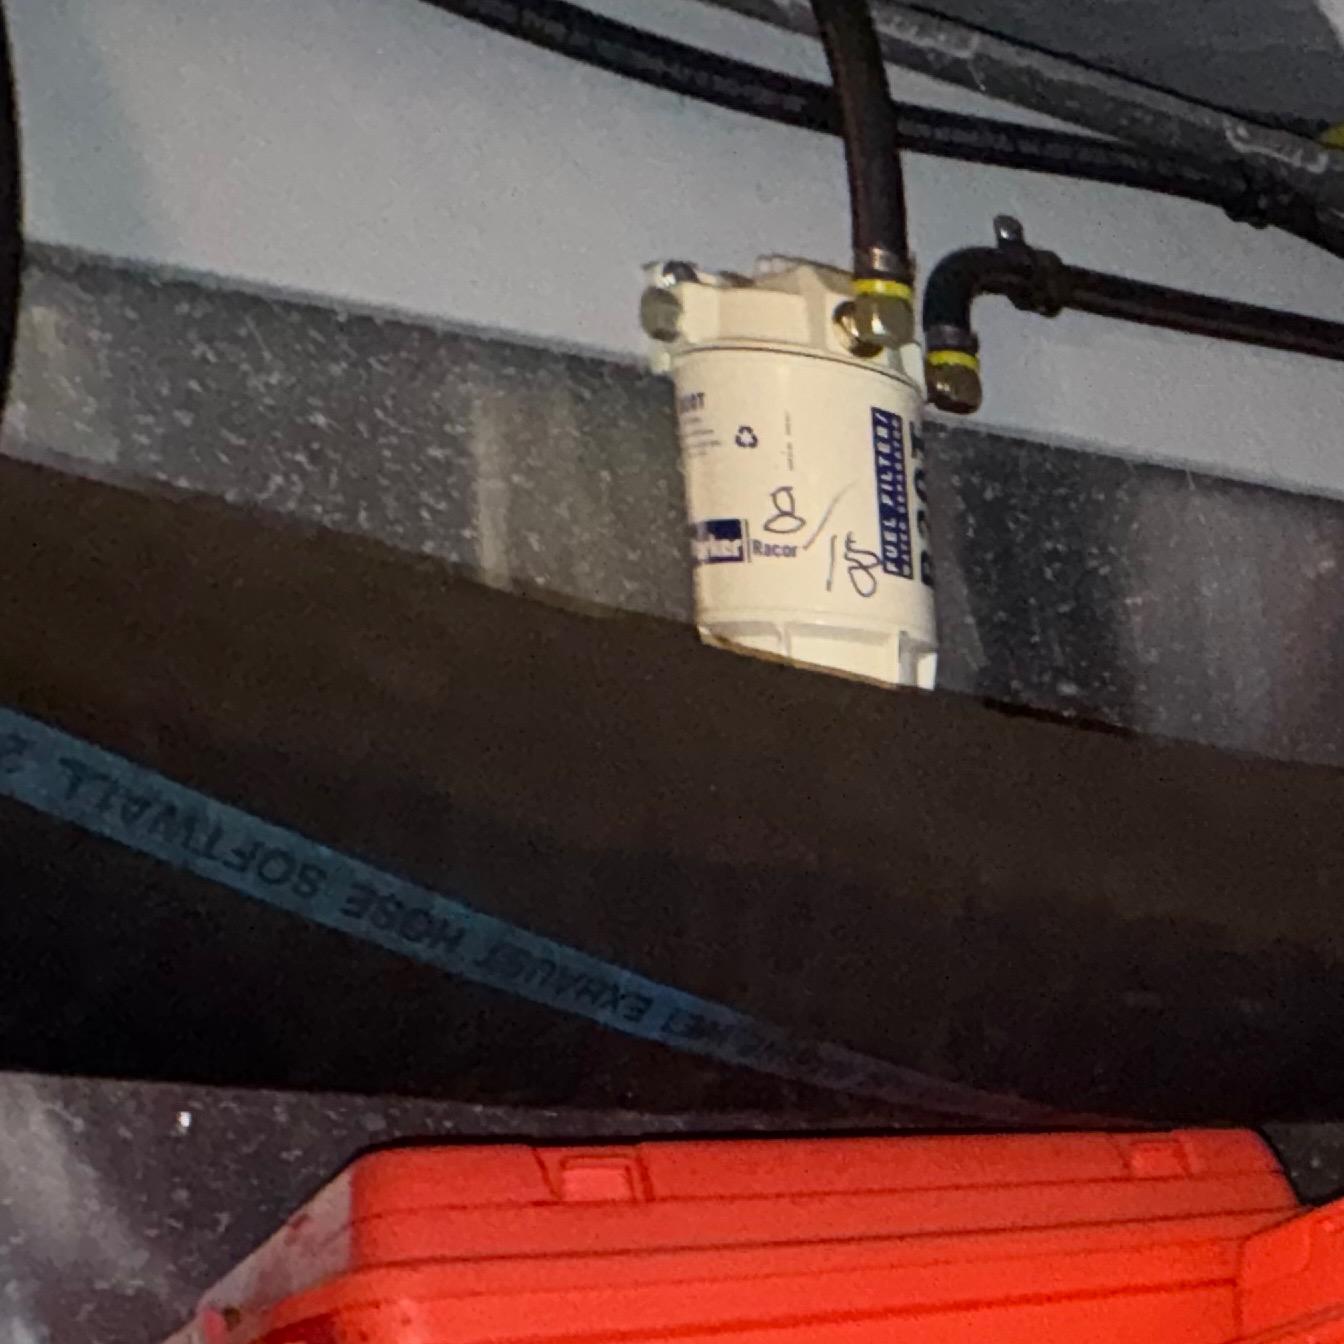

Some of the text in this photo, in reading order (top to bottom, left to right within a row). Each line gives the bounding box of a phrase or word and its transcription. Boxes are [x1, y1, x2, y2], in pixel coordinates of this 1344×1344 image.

[752, 539, 798, 557] Racor
[882, 515, 899, 572] FUEL
[58, 755, 327, 899] SOFTWALL
[340, 882, 467, 952] HOSE
